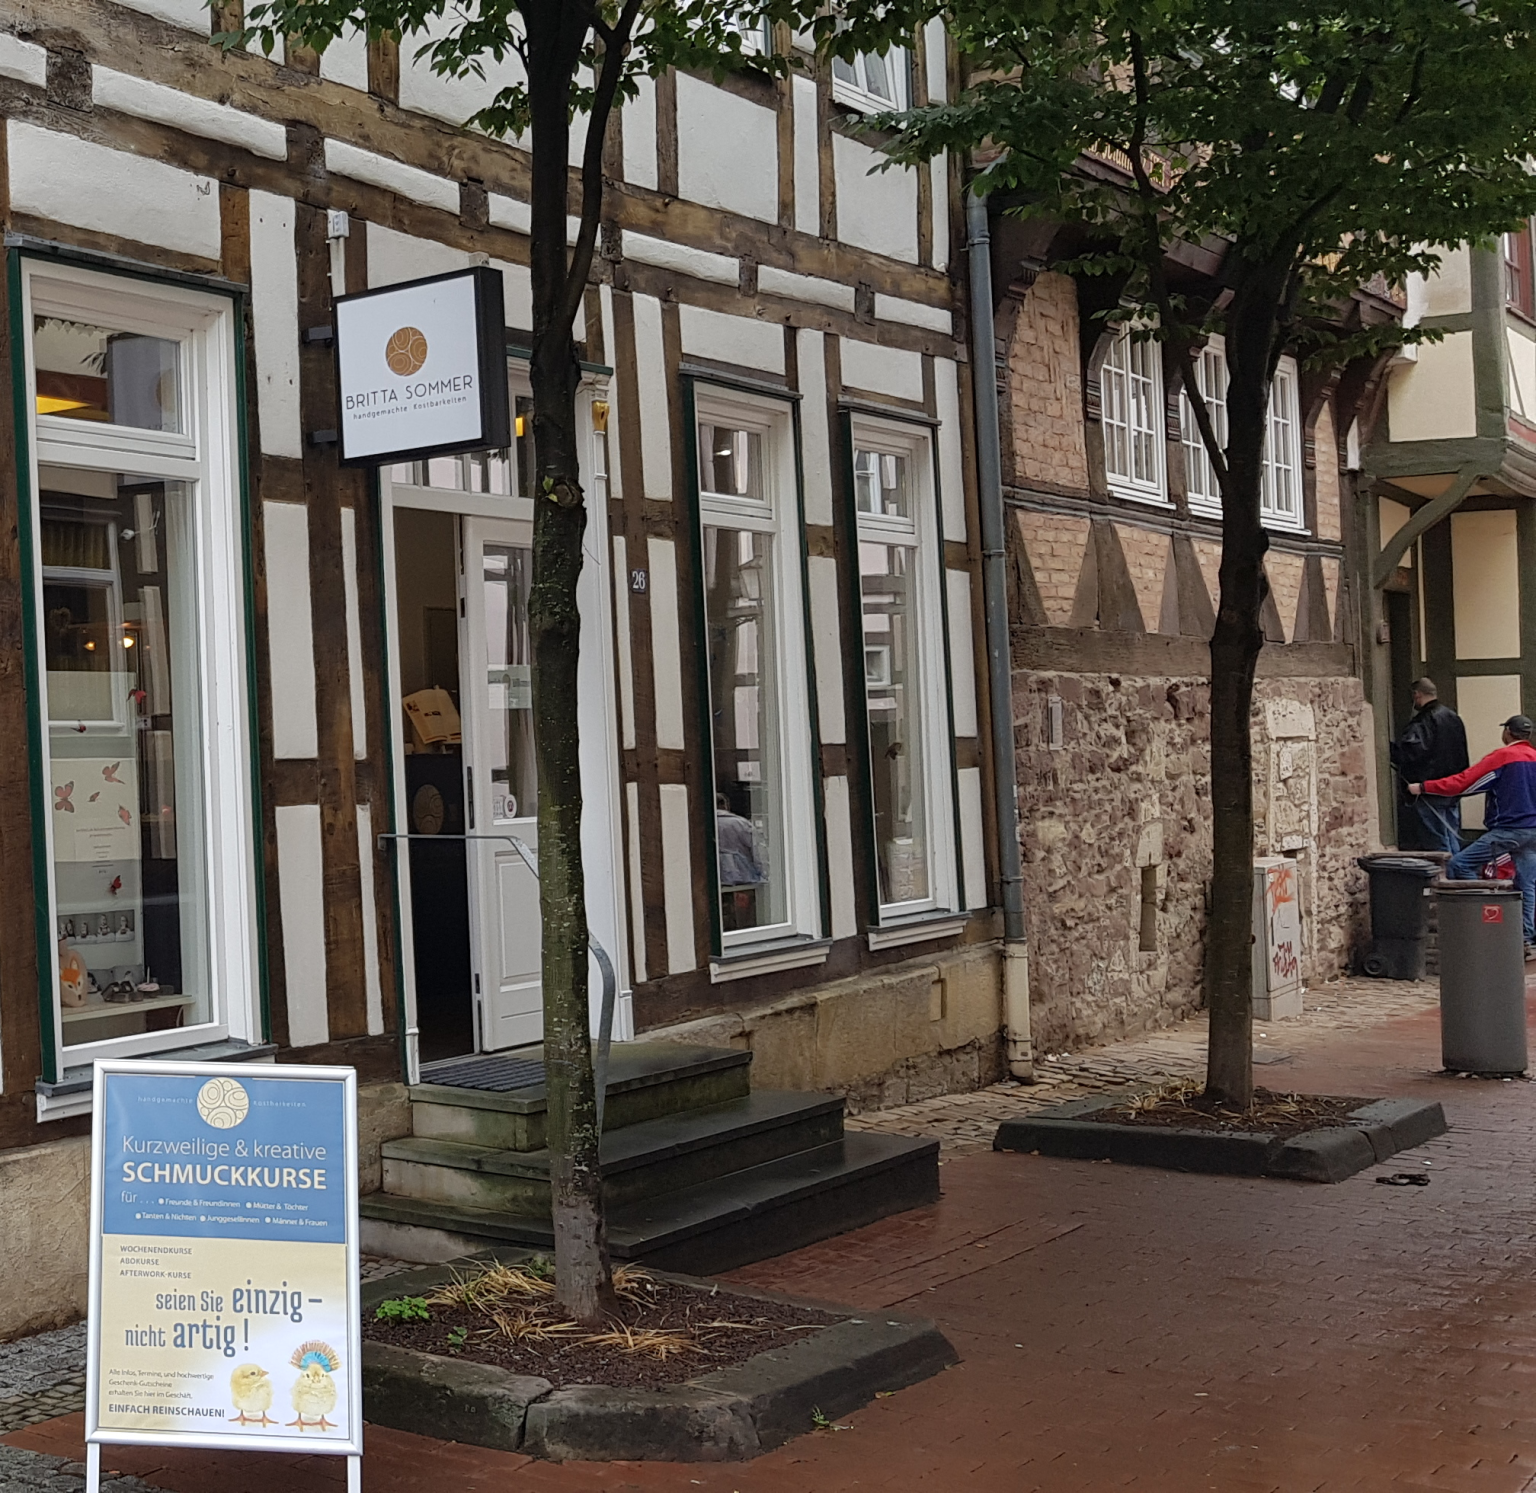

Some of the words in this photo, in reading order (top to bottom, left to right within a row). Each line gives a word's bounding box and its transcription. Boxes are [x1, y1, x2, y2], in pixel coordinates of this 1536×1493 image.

[346, 389, 398, 410] BRITTA
[405, 374, 473, 399] SOMMER
[353, 405, 408, 420] handgemachte
[413, 396, 467, 410] Kostbarkeiten
[632, 571, 645, 589] 26
[122, 1135, 230, 1160] Kurzweilige
[235, 1139, 249, 1157] &
[254, 1139, 326, 1160] kreative
[122, 1161, 327, 1189] SCHMUCKKURSE
[121, 1190, 138, 1203] für
[166, 1198, 192, 1206] Freunde
[199, 1199, 241, 1209] Freundinnen
[284, 1203, 308, 1211] Töchter
[171, 1213, 197, 1221] Nichten
[273, 1217, 297, 1225] Männer
[305, 1219, 328, 1227] Frauen
[120, 1245, 192, 1255] WOCHENENDKURSE
[120, 1257, 160, 1266] ABOKURSE
[120, 1269, 192, 1279] AFTERWORK-KURSE
[156, 1289, 196, 1312] seien
[200, 1290, 224, 1313] Sie
[232, 1279, 303, 1323] einzig
[125, 1324, 166, 1347] nicht
[177, 1371, 214, 1381] hochwertige
[109, 1403, 150, 1415] EINFACH
[152, 1405, 225, 1418] REINSCHAUEN!
